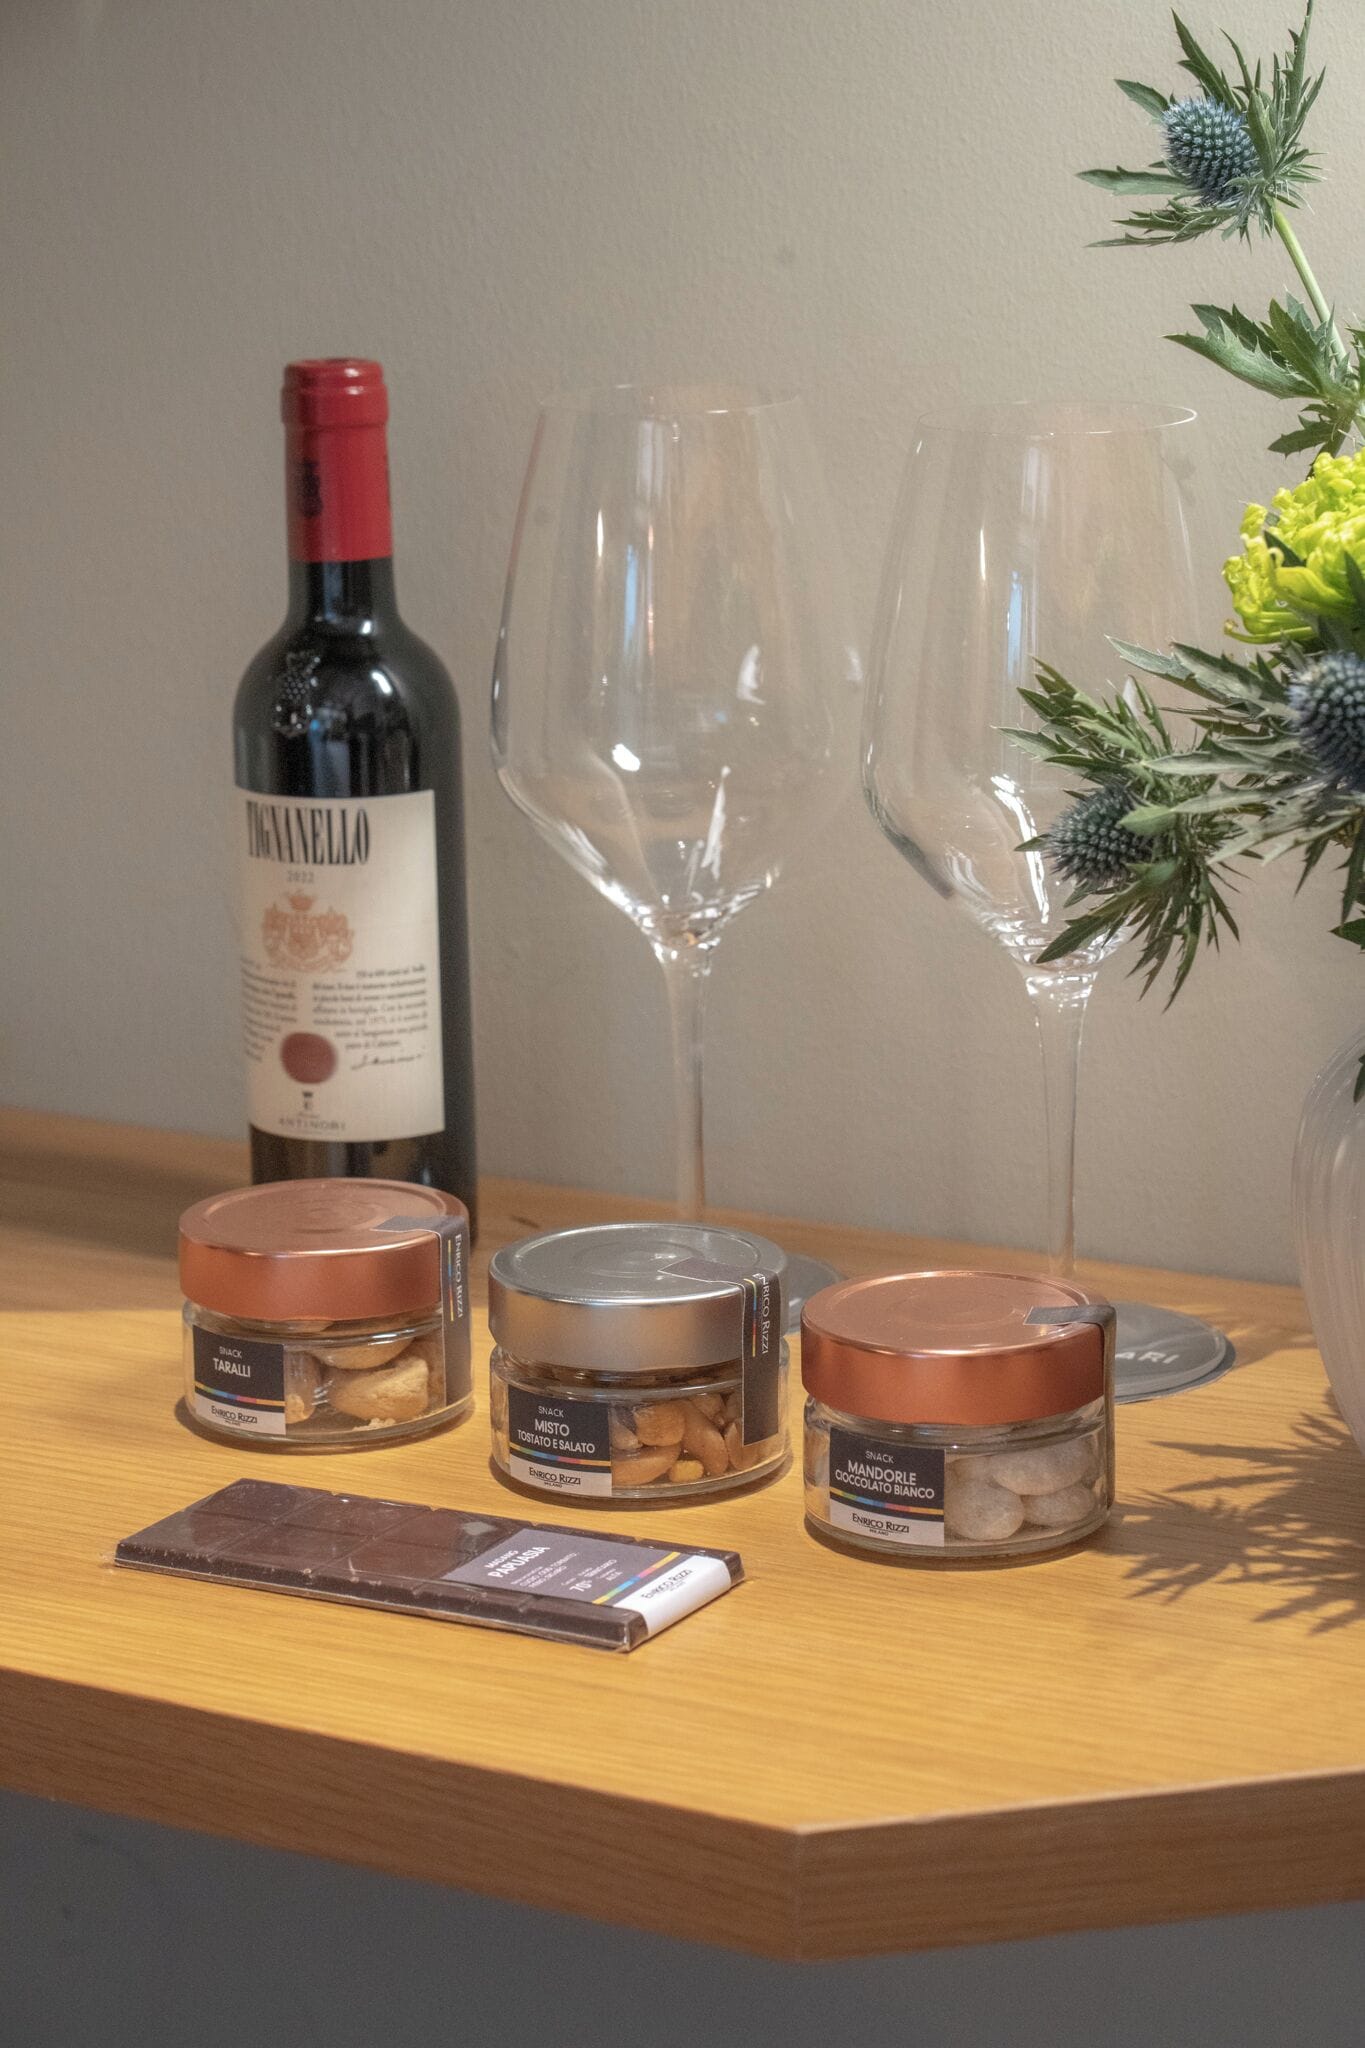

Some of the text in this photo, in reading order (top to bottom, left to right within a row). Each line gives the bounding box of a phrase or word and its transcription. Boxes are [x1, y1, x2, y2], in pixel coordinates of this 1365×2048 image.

[752, 1273, 770, 1354] ENRICO RIZZI
[219, 1346, 242, 1359] SNACK
[213, 1358, 251, 1377] TARALLI
[211, 1405, 236, 1420] ENRICO
[238, 1413, 258, 1424] RIZZI
[538, 1405, 565, 1419] SNACK
[534, 1418, 571, 1437] MISTO
[517, 1429, 597, 1454] TOSTATO E SALATO
[865, 1450, 895, 1464] SNACK
[529, 1467, 581, 1485] ENRICO RIZZI
[847, 1459, 917, 1486] MANDORLE
[835, 1468, 936, 1500] CIOCCOLATO BIANCO
[852, 1513, 910, 1533] ENRICO RIZZI
[487, 1546, 551, 1579] PAPUASIA
